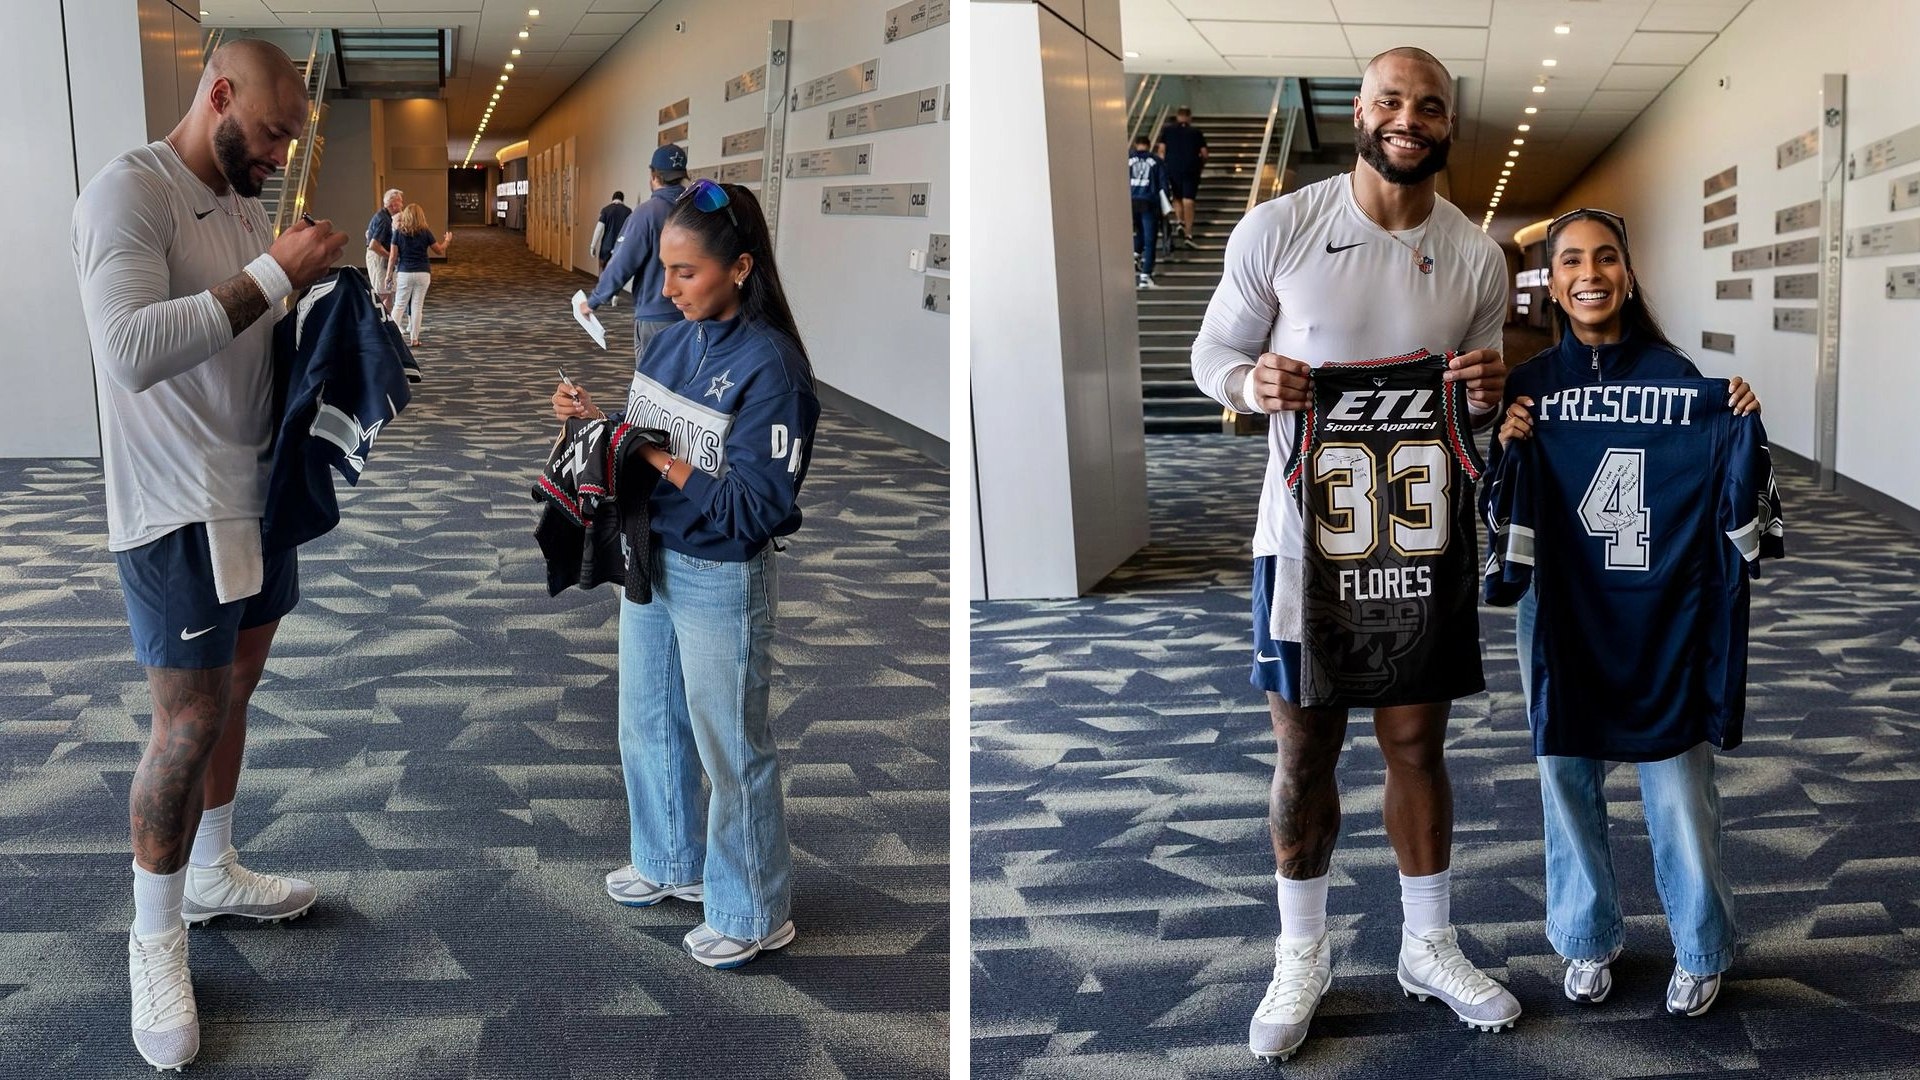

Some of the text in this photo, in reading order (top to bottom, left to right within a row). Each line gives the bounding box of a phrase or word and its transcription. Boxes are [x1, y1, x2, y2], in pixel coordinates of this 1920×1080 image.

[864, 70, 875, 82] DT
[920, 98, 936, 113] MLB
[858, 154, 868, 165] DE
[911, 194, 926, 206] OLB
[1326, 389, 1435, 421] ETL
[1539, 385, 1698, 426] PRESCOTT
[1323, 421, 1438, 432] Sports Apparel
[1313, 438, 1452, 561] 33
[1578, 448, 1650, 571] 4
[1339, 564, 1432, 602] FLORES
